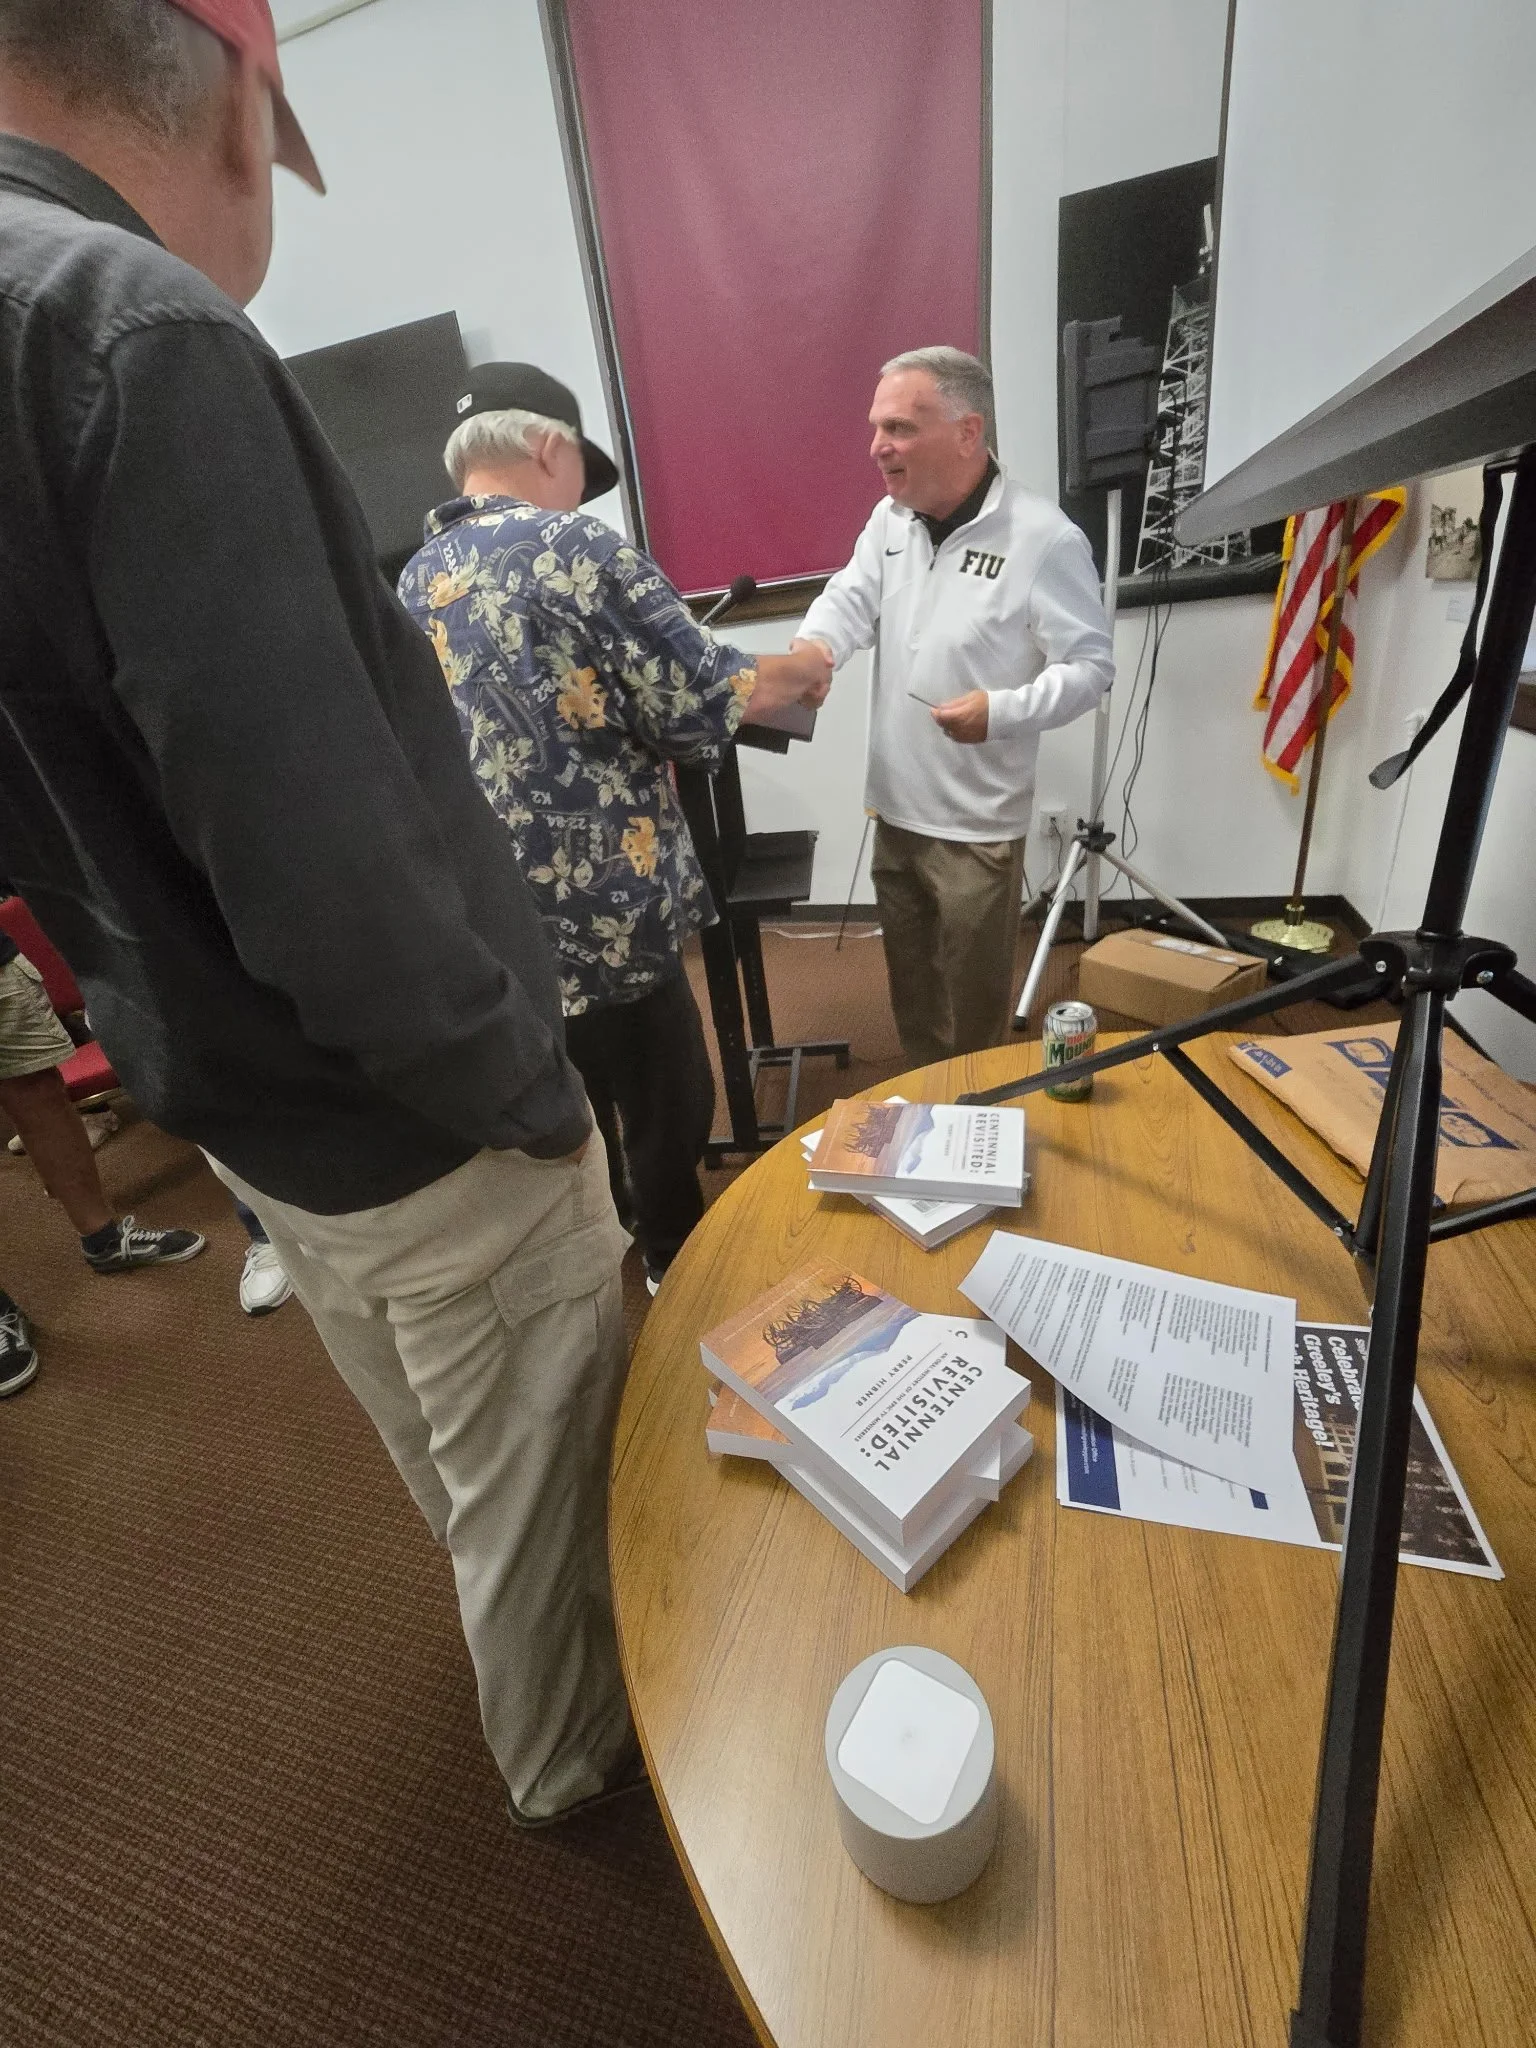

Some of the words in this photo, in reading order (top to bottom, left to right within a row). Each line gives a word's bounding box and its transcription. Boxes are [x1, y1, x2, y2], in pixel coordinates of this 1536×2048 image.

[959, 549, 1006, 580] FIU
[970, 1113, 987, 1173] REVISITED:
[984, 1113, 999, 1174] CENTENNIAL
[888, 1355, 913, 1377] PERRY
[912, 1370, 930, 1386] HISTORY
[931, 1358, 942, 1369] ORAL
[1303, 1334, 1342, 1405] Greeley's
[856, 1378, 887, 1406] HIBNER
[860, 1356, 969, 1458] REVISITED:
[888, 1400, 898, 1411] EPIC
[874, 1366, 983, 1471] CENTENNIAL
[1294, 1369, 1335, 1448] Heritage!
[854, 1417, 881, 1442] MINISERIES
